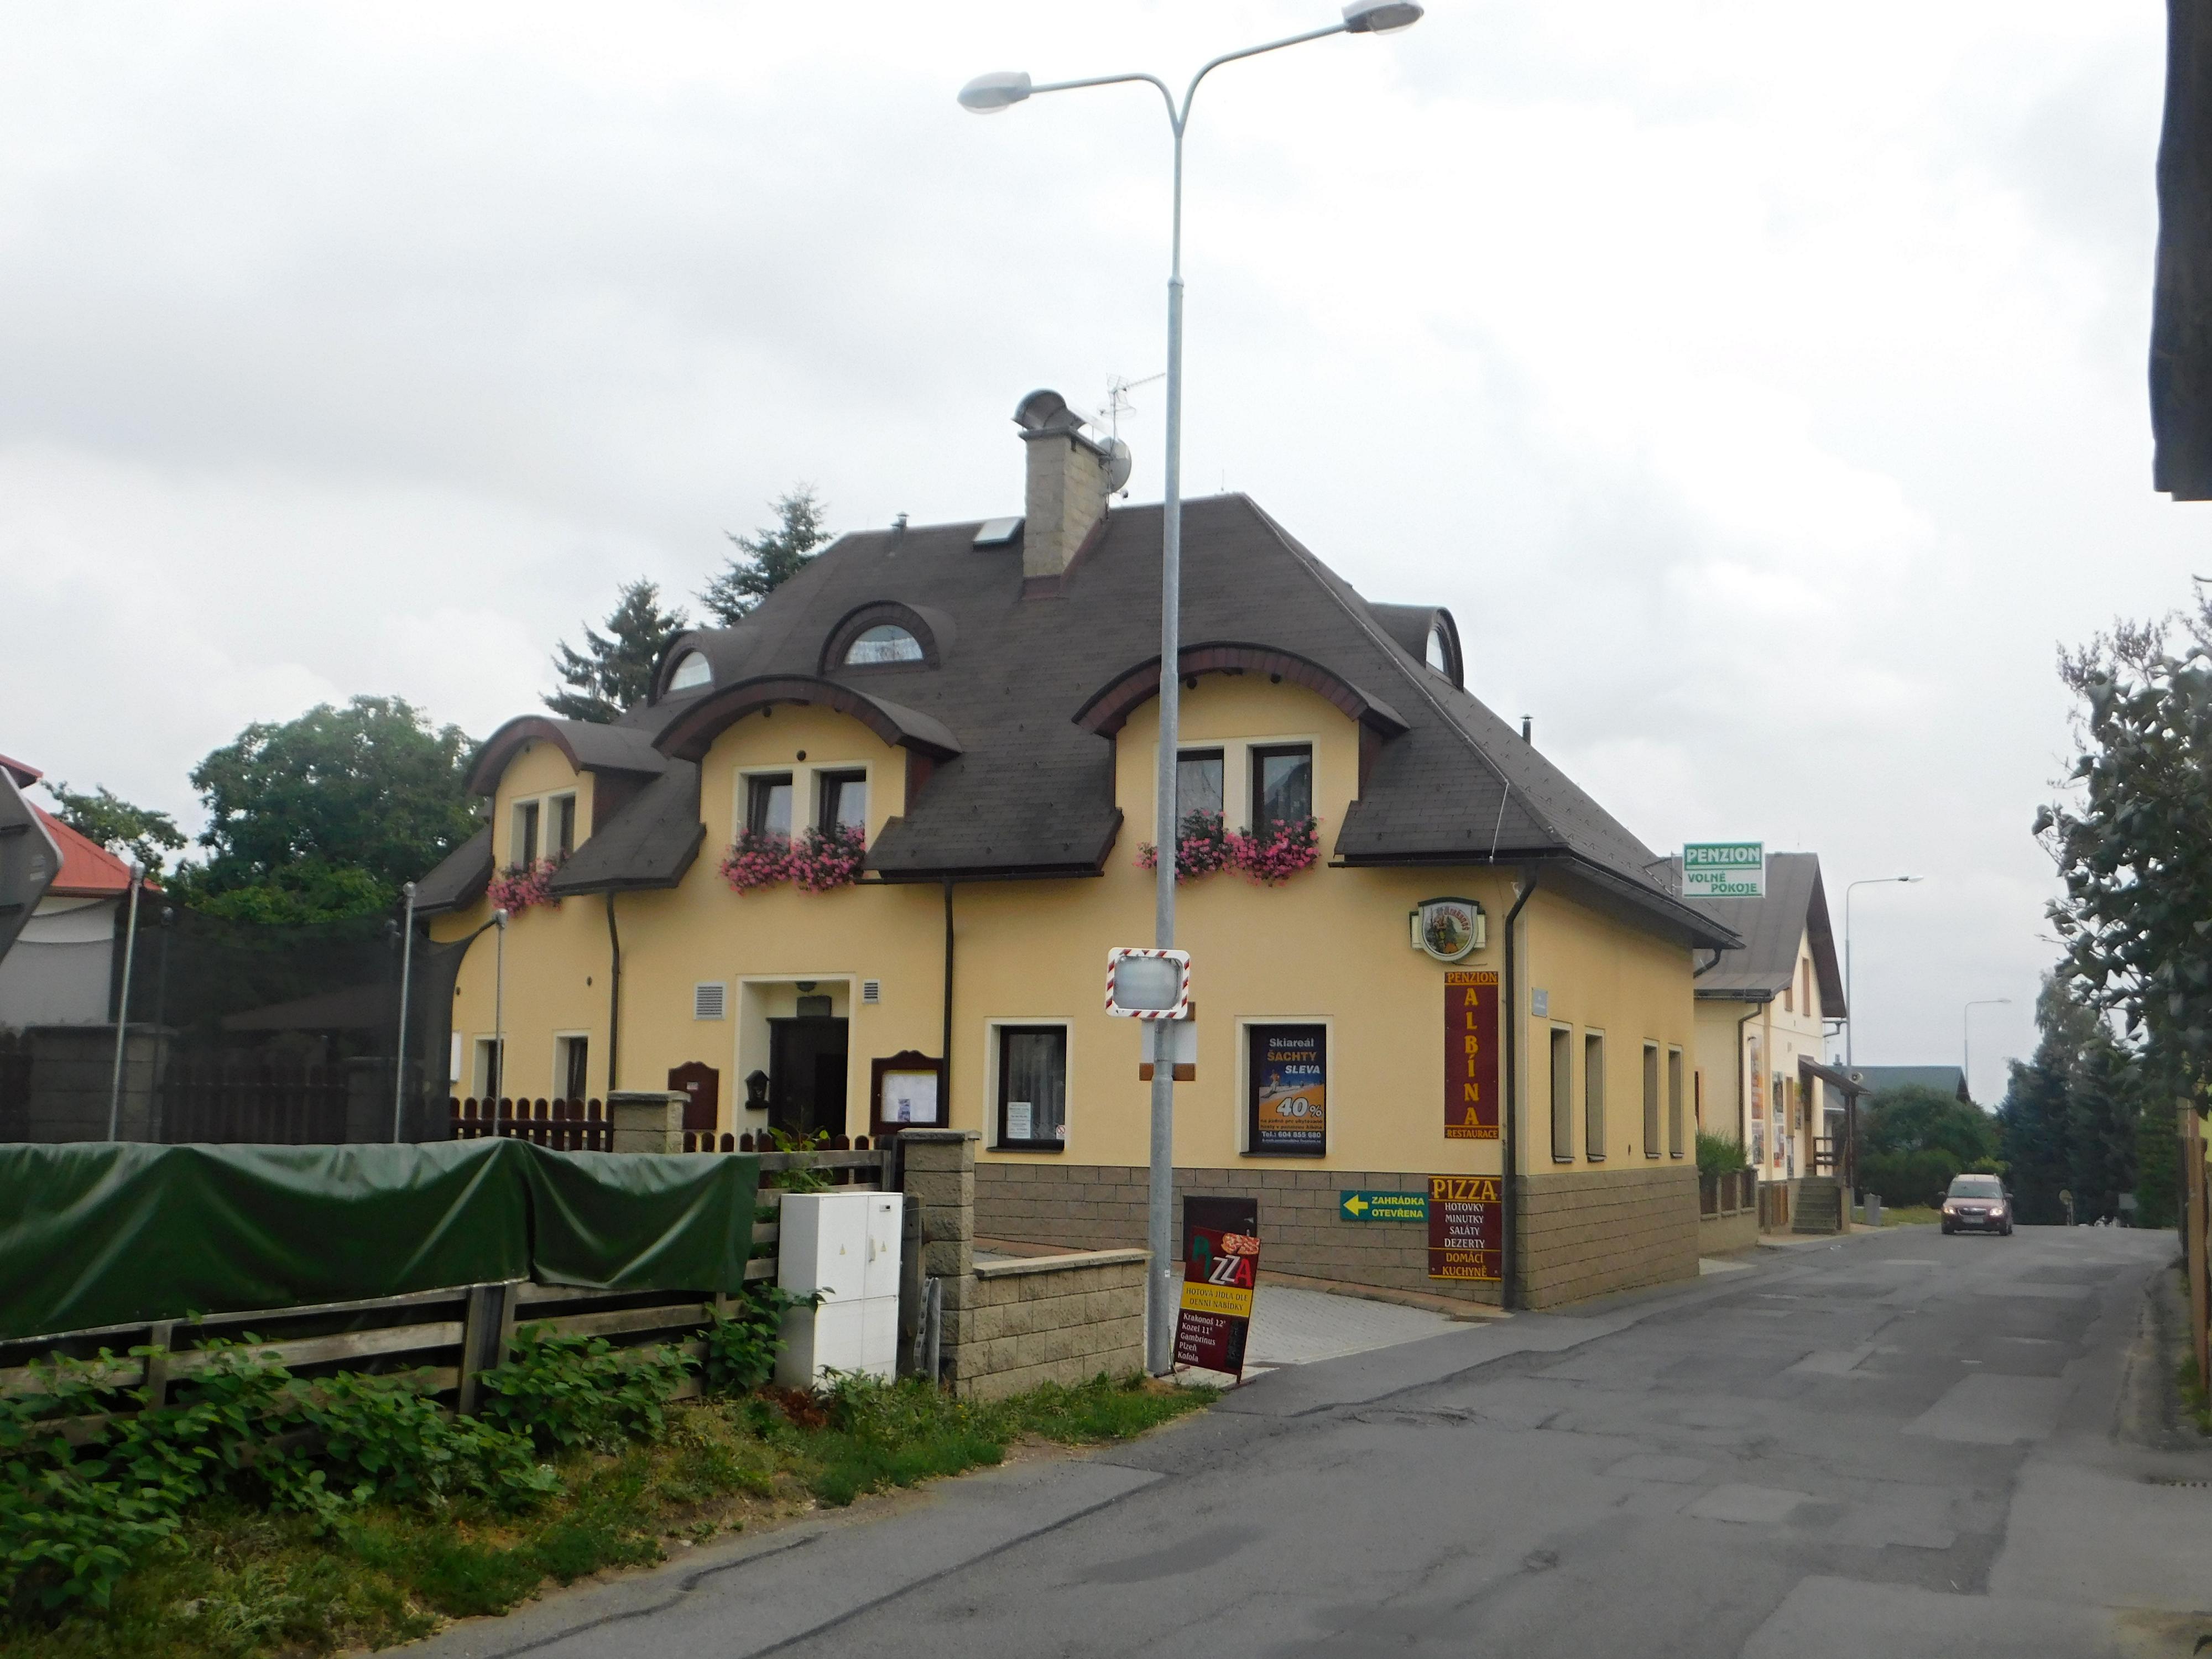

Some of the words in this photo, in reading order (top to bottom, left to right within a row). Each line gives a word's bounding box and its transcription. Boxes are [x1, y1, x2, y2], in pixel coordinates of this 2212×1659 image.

[1686, 847, 1760, 863] PENZION
[1688, 870, 1726, 883] VOLNÉ
[1710, 883, 1757, 894] POKOJE
[1447, 972, 1498, 983] PENZION
[1269, 1037, 1314, 1047] Skiareál
[1267, 1049, 1317, 1061] ŠACHTY
[1285, 1065, 1320, 1074] SLEVA
[1447, 1129, 1498, 1139] RESTAURACE
[1432, 1179, 1496, 1201] PIZZA
[1371, 1194, 1425, 1206] ZAHRÁDKA
[1371, 1207, 1424, 1218] OTEVŘENA
[1444, 1202, 1484, 1212] HOTOVKY
[1445, 1214, 1484, 1224] MINUTKY
[1449, 1225, 1480, 1236] SALÁTY
[1444, 1238, 1485, 1249] DEZERTY
[1446, 1251, 1483, 1264] DOMÁCÍ
[1442, 1265, 1488, 1277] KUCHYNĚ
[1186, 1287, 1213, 1297] HOTOVÁ
[1183, 1312, 1214, 1325] Krakonoš
[1182, 1322, 1200, 1332] Kozel
[1180, 1332, 1215, 1345] Gambrinus
[1179, 1341, 1197, 1352] Plzeň
[1177, 1350, 1199, 1363] Kofola
